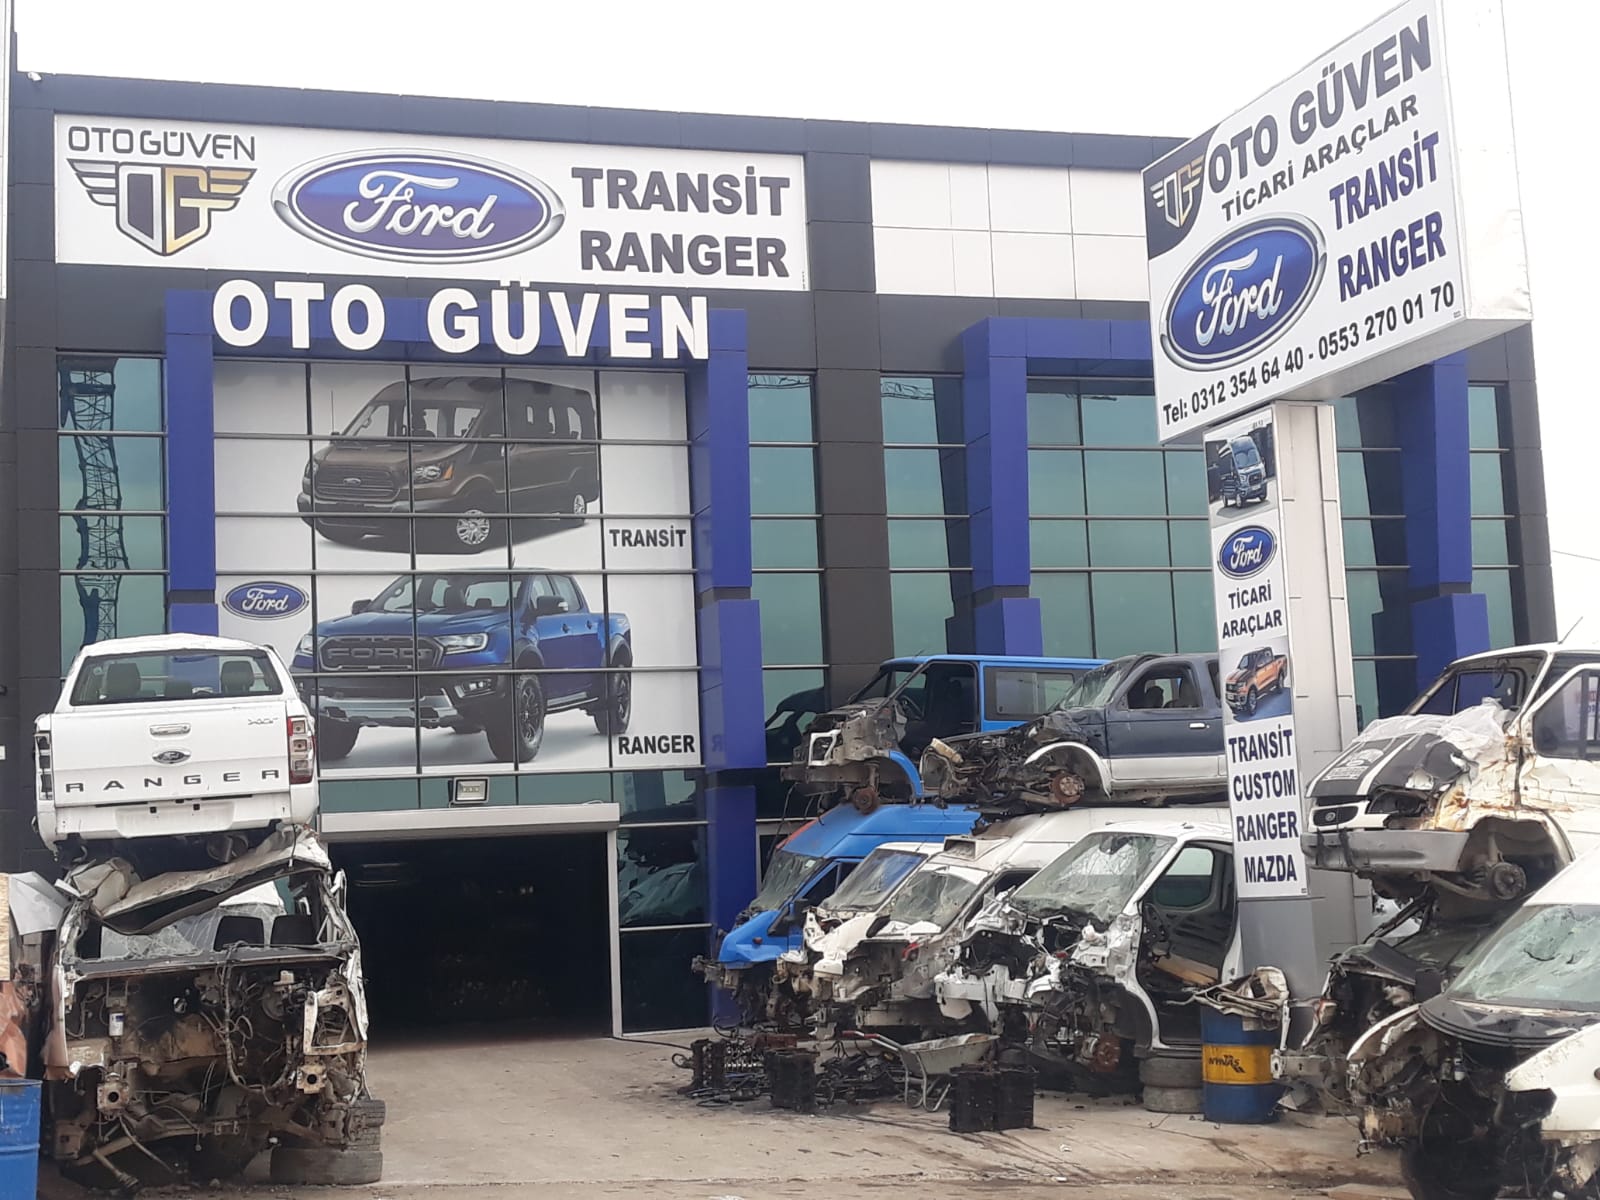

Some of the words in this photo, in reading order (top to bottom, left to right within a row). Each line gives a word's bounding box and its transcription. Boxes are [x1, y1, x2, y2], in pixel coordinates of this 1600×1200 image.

[1207, 114, 1278, 194] OTO
[1290, 15, 1432, 145] GÜVEN
[68, 126, 133, 153] OTO
[140, 130, 255, 161] GÜVEN
[1222, 160, 1294, 222] TİCARİ
[1302, 94, 1419, 180] ARAÇLAR
[571, 166, 791, 218] TRANSİT
[1329, 130, 1439, 230] TRANSİT
[343, 169, 498, 241] Ford
[580, 234, 790, 279] RANGER
[1337, 210, 1447, 302] RANGER
[1195, 248, 1284, 346] Ford
[212, 280, 386, 351] OTO
[426, 279, 709, 361] GÜVEN
[1162, 400, 1188, 426] Tel:
[1191, 380, 1226, 414] 0312
[1230, 369, 1257, 399] 354
[1261, 359, 1280, 384] 64
[1285, 347, 1304, 374] 40
[1318, 321, 1360, 361] 0553
[1365, 305, 1397, 341] 270
[1403, 294, 1424, 324] 01
[1431, 281, 1455, 312] 70
[609, 525, 687, 548] TRANSİT
[1230, 536, 1263, 570] Ford
[242, 588, 289, 611] Ford
[1228, 579, 1272, 609] TİCARİ
[1222, 609, 1283, 639] ARAÇLAR
[618, 735, 695, 755] RANGER
[1228, 724, 1293, 763] TRANSİT
[65, 768, 280, 793] RANGER
[1233, 769, 1296, 802] CUSTOM
[1236, 811, 1299, 842] RANGER
[1244, 854, 1298, 883] MAZDA
